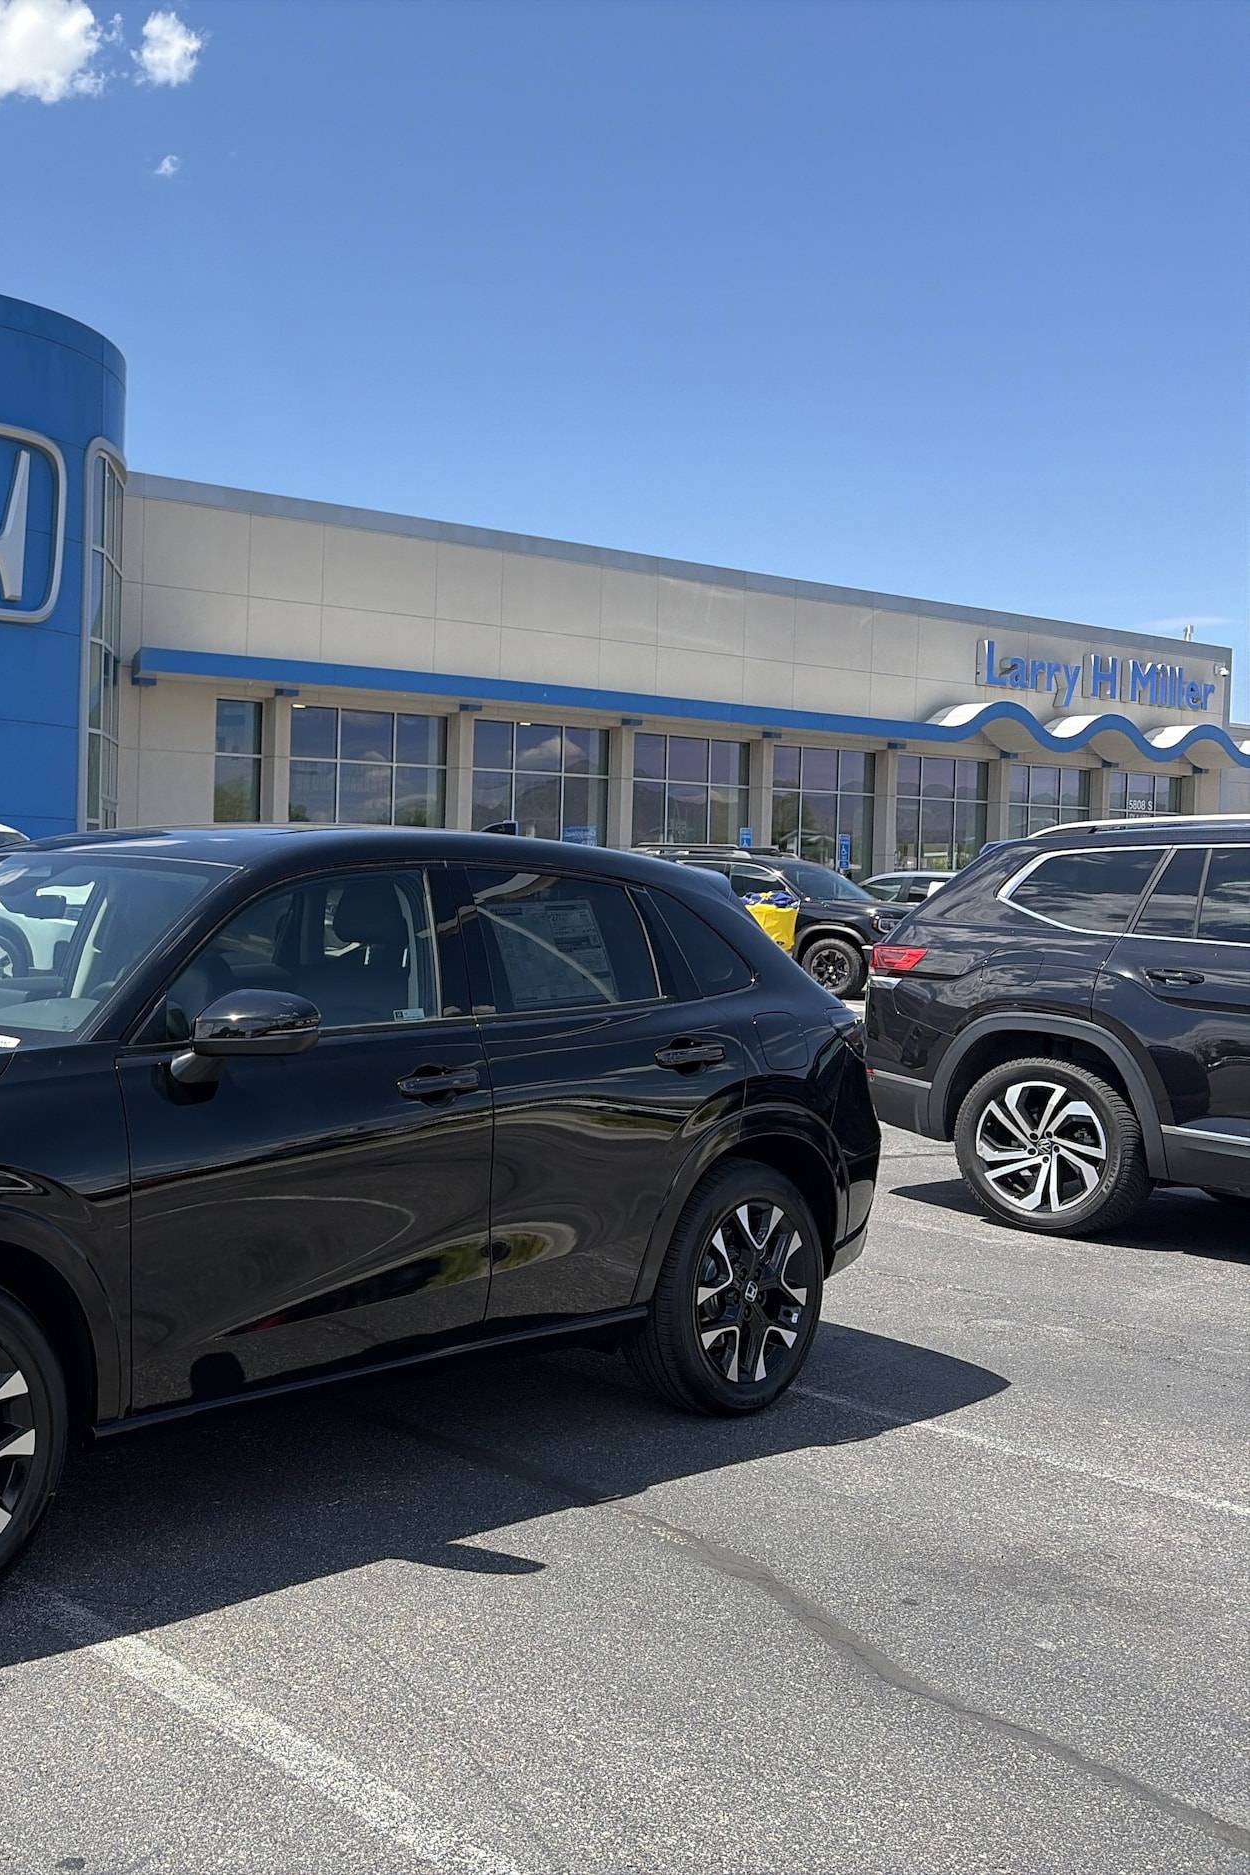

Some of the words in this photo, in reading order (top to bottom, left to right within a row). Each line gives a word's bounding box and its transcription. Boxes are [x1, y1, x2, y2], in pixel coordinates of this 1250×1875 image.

[983, 639, 1082, 708] Larry
[1090, 653, 1118, 700] H
[1128, 659, 1216, 711] Miller
[1128, 799, 1146, 811] 5808
[1147, 800, 1154, 811] S
